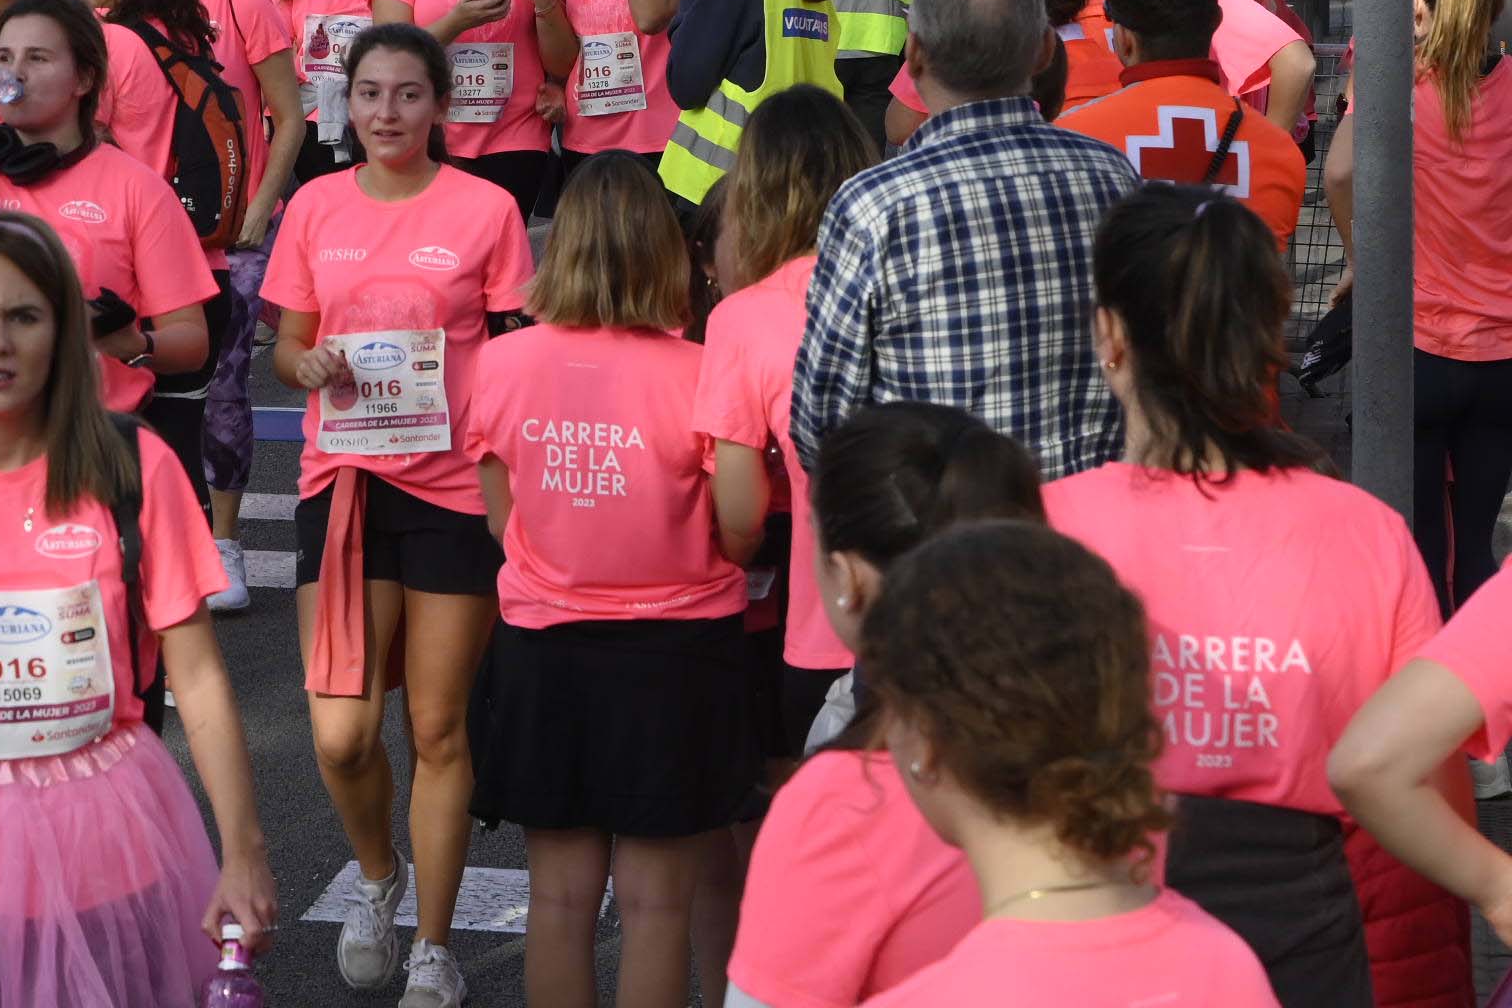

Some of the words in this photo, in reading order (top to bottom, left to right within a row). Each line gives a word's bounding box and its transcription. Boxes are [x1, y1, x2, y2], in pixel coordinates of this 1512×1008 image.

[585, 66, 611, 78] 016
[455, 75, 485, 86] 016
[589, 81, 609, 89] 13278
[459, 89, 481, 97] 13277
[320, 248, 366, 262] OYSHO
[410, 345, 436, 353] SUMA
[357, 354, 402, 365] ASTURIANA
[361, 380, 402, 398] 016
[366, 403, 397, 414] 11966
[391, 417, 417, 425] MUJER
[400, 433, 440, 443] Santander
[521, 419, 645, 449] CARRERA
[330, 437, 369, 447] OYSHO
[546, 445, 578, 467] DE
[589, 449, 621, 472] LA
[541, 472, 627, 496] MUJER
[572, 498, 595, 507] 2023
[1151, 636, 1312, 675] ARRERA
[1154, 676, 1205, 708] DE
[1224, 676, 1271, 709] LA
[0, 710, 13, 720] DE
[16, 708, 30, 719] LA
[33, 705, 70, 718] MUJER
[1196, 754, 1233, 769] 2023
